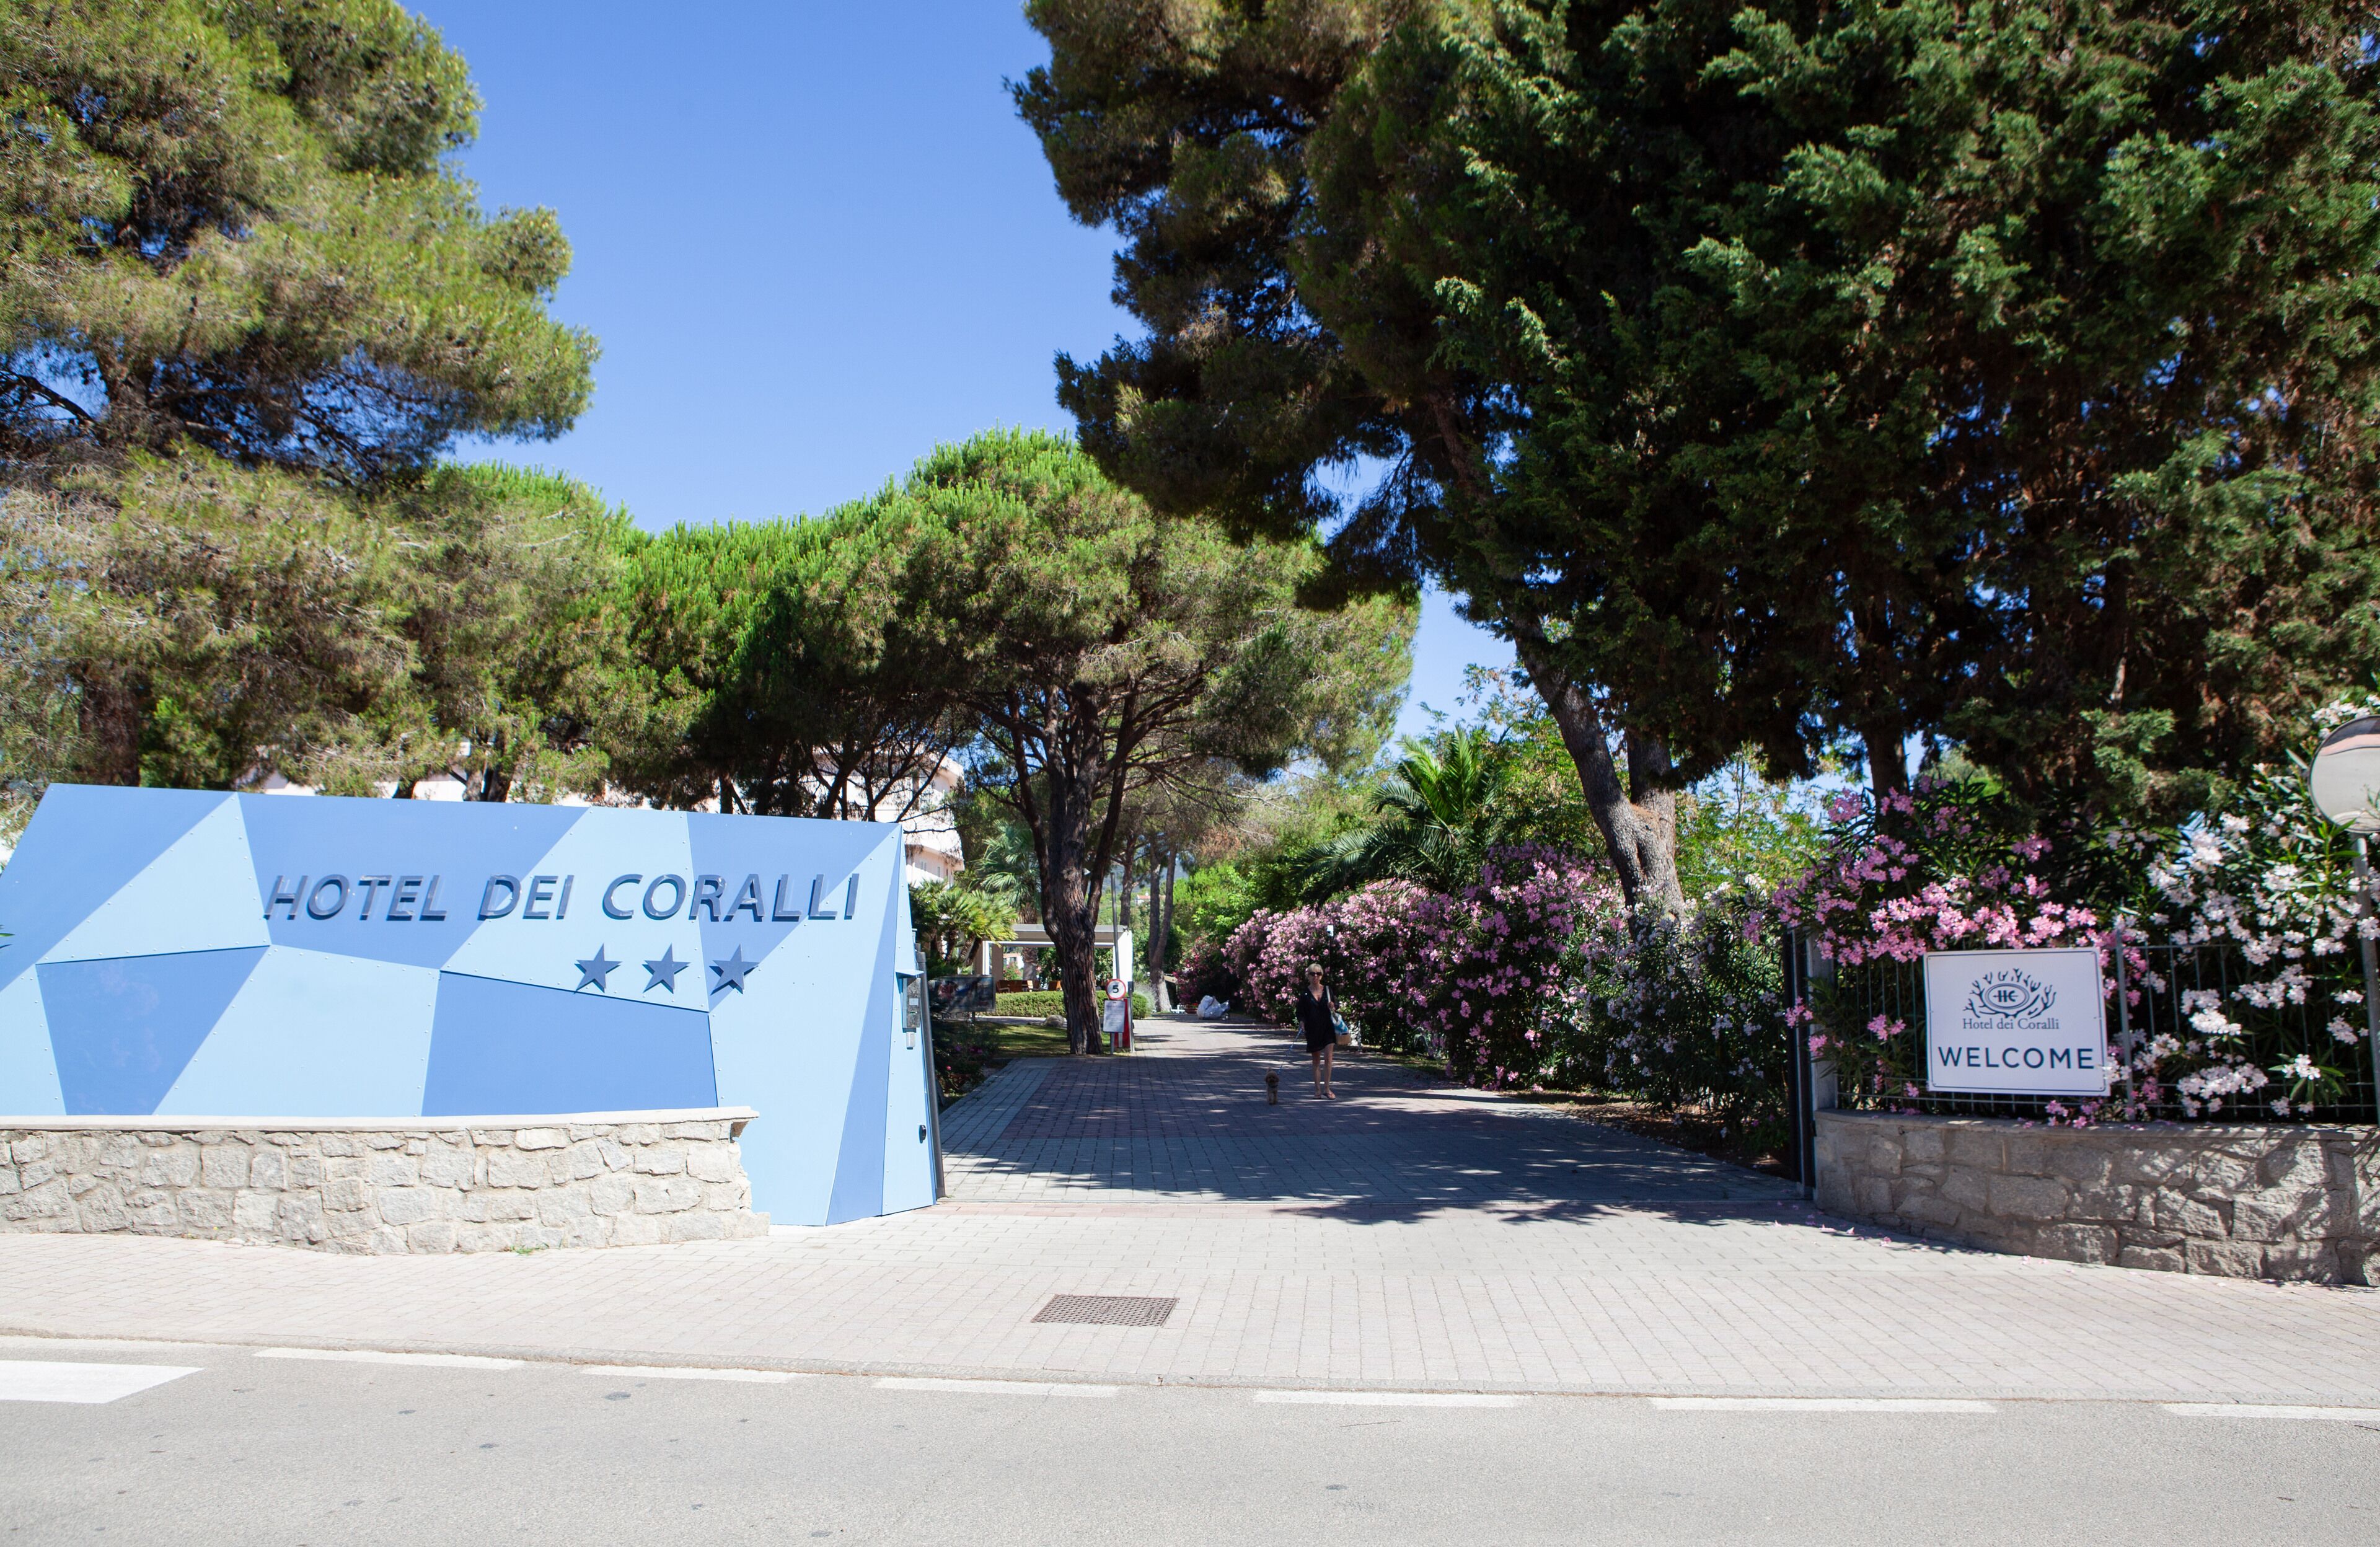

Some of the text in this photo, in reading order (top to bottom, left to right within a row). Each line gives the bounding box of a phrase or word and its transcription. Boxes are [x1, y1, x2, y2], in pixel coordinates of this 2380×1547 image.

[263, 873, 860, 922] HOTEL DEI CORALLI
[1113, 985, 1119, 993] 5
[1962, 1018, 2060, 1029] Hotel dei Coralli
[1939, 1046, 2094, 1069] WELCOME
